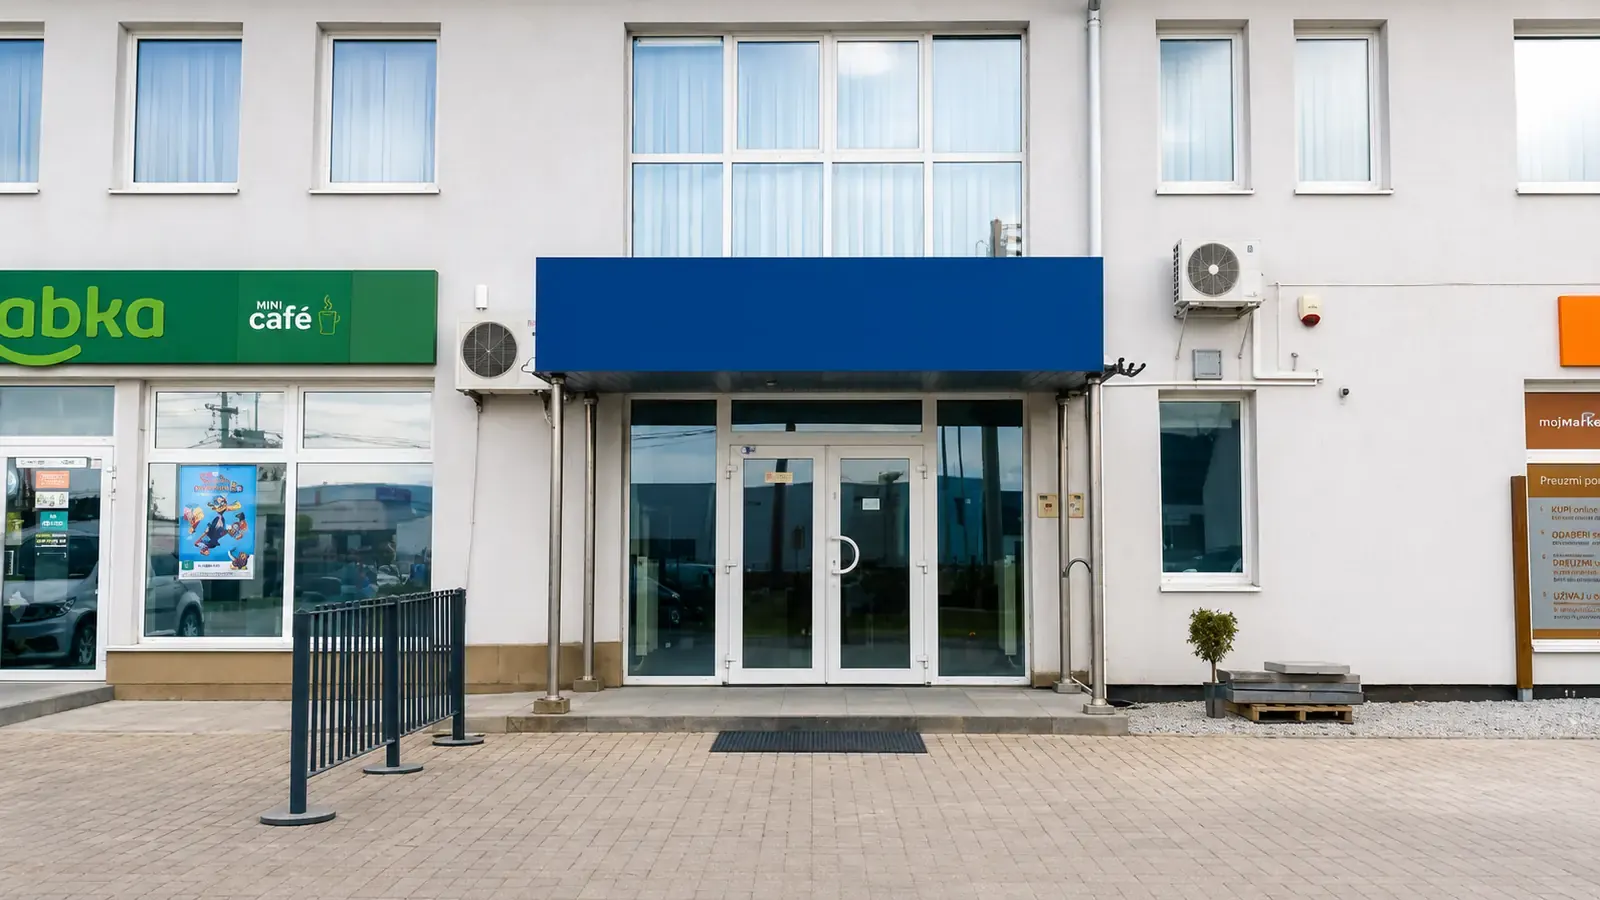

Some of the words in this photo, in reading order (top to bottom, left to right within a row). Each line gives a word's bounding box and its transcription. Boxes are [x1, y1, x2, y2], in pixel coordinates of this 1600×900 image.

[256, 300, 283, 310] MINI
[249, 305, 312, 330] café
[1540, 475, 1582, 486] Preuzmi
[1551, 505, 1572, 514] KUPI
[1552, 530, 1591, 540] ODABERI
[1553, 591, 1585, 601] UŽIVAJ
